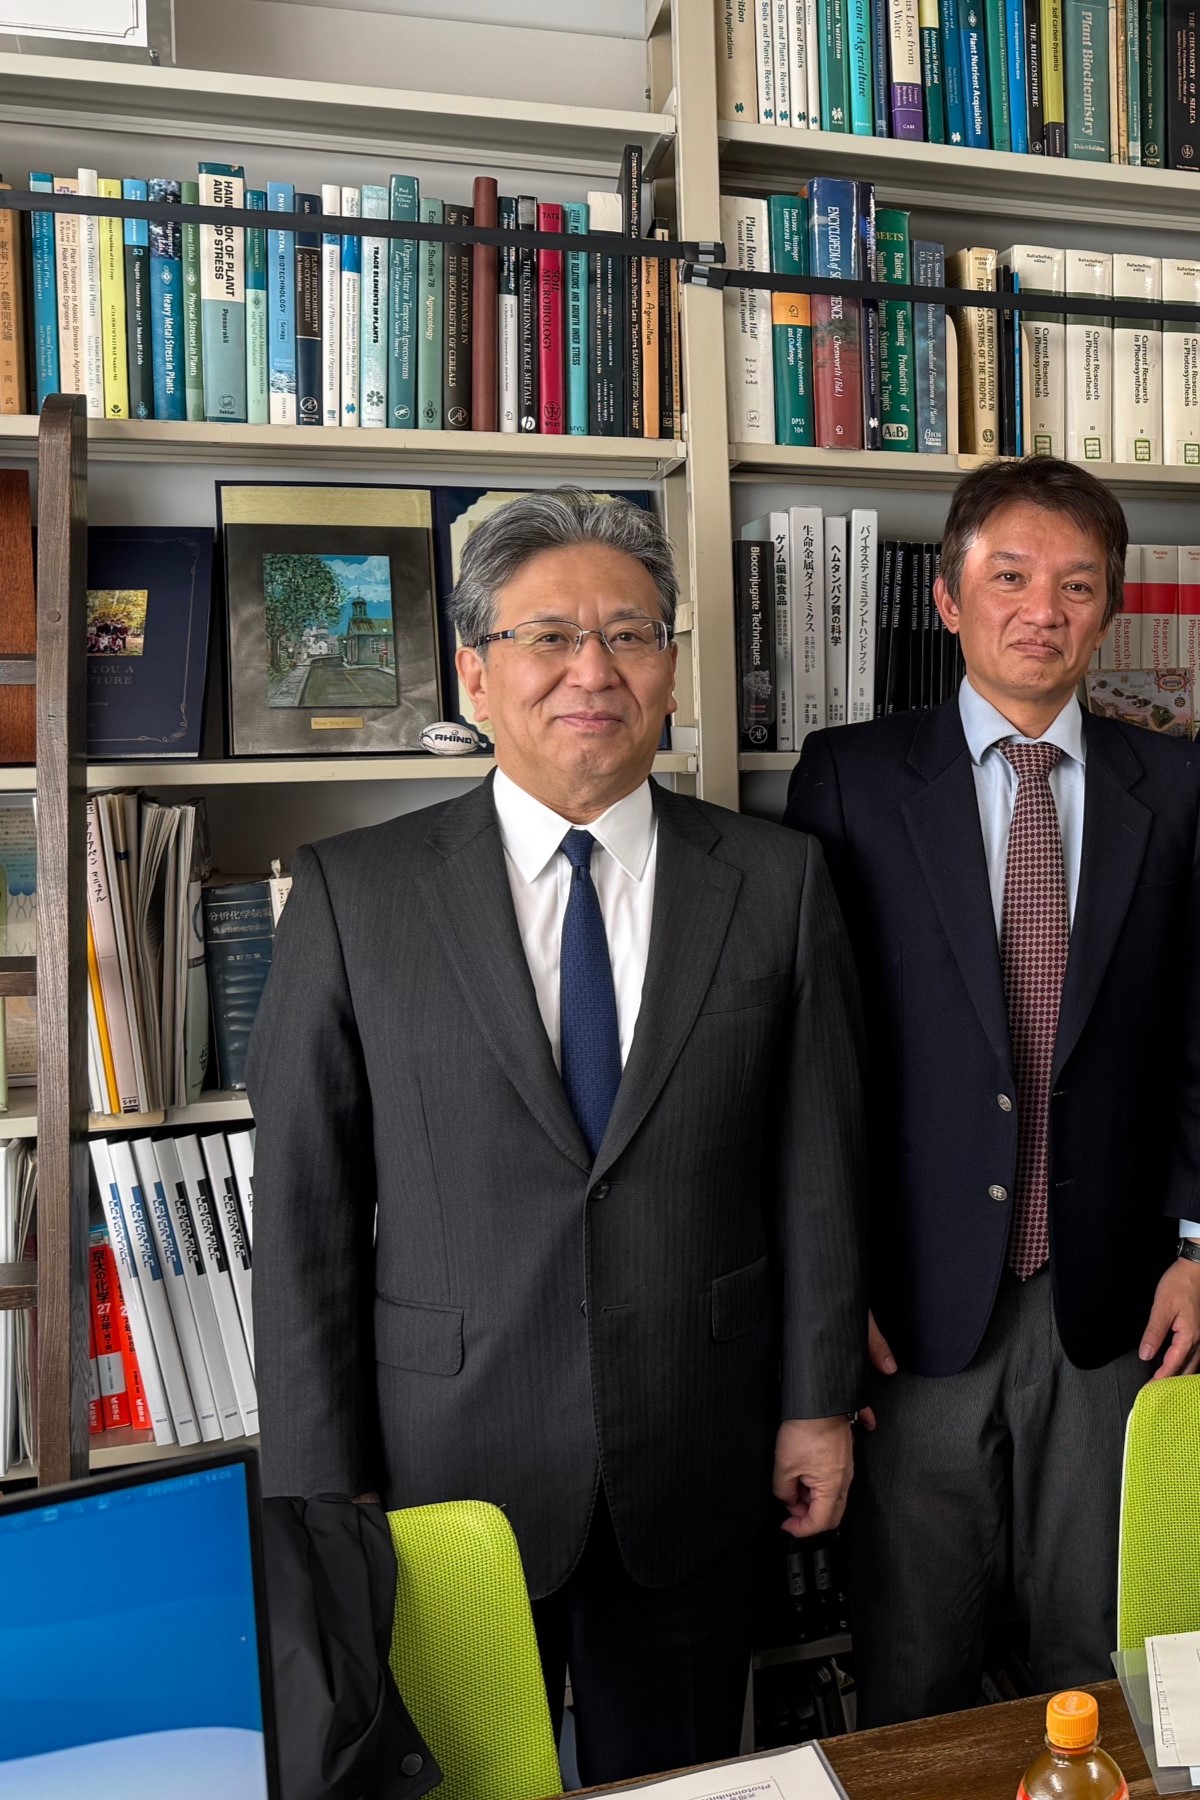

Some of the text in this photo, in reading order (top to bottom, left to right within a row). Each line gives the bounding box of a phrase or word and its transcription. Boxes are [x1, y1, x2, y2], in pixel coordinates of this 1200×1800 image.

[970, 33, 982, 135] Plant Nutrient Acquisition
[1030, 44, 1039, 107] RHIZOSPHERE
[1081, 11, 1095, 136] Plant Biochemistry
[213, 179, 225, 280] AND STRESS
[225, 244, 235, 259] OF
[402, 245, 412, 269] Organic
[745, 216, 756, 243] Plant
[827, 206, 840, 262] ENCYCLOPEDIA
[225, 262, 235, 297] PLANT
[279, 254, 287, 313] BIOTECHNOLOGY
[311, 254, 319, 332] PLANT HISTOCHEMISTRY
[402, 271, 412, 291] Matter
[551, 269, 560, 293] SOIL
[829, 262, 840, 270] of
[892, 252, 905, 279] Raising
[187, 292, 198, 318] Physical
[188, 320, 198, 347] Stresses
[401, 300, 413, 332] Temperate
[426, 295, 436, 340] Agroecology
[448, 255, 457, 387] THE BIOCHEMISTRY OF CEREALS
[522, 259, 532, 406] THE NUTRITIONAL TRACE METALS
[542, 267, 553, 352] MICROBIOLOGY
[571, 262, 580, 366] RELATIONS AND GROWTH UNDER STRESS
[644, 302, 655, 346] Agriculture
[748, 294, 757, 320] Hidden
[748, 322, 758, 340] Half
[895, 309, 907, 347] Sustaining
[976, 313, 985, 348] SYSTEMS
[163, 293, 176, 394] Heavy Metal Stress in Plants
[189, 355, 198, 376] Plants
[401, 332, 412, 380] Agroecosystems
[832, 335, 844, 397] Chesworth (Ed.)
[877, 300, 892, 411] Farming Systems in the Tropics
[977, 349, 985, 360] OF
[977, 361, 986, 375] THE
[986, 325, 996, 411] NITROGEN FIXATION IN
[897, 354, 909, 397] Productivity
[977, 376, 987, 410] TROPICS
[775, 534, 788, 606] ゲノム編集食品
[802, 525, 815, 632] 生命金属ダイナミクス
[830, 545, 842, 647] ヘムタンパク質の科学
[749, 546, 763, 666] Bioconjugate Techniques
[858, 526, 872, 675] バイオスティミュラントハンドブック
[434, 733, 473, 744] RHINO
[108, 1199, 132, 1266] LEVER FILE
[130, 1202, 155, 1268] LEVER FILE
[152, 1198, 177, 1264] LEVER FILE
[174, 1198, 199, 1264] LEVER FILE
[196, 1195, 220, 1261] LEVER FILE
[223, 1193, 246, 1258] LEVER FILE
